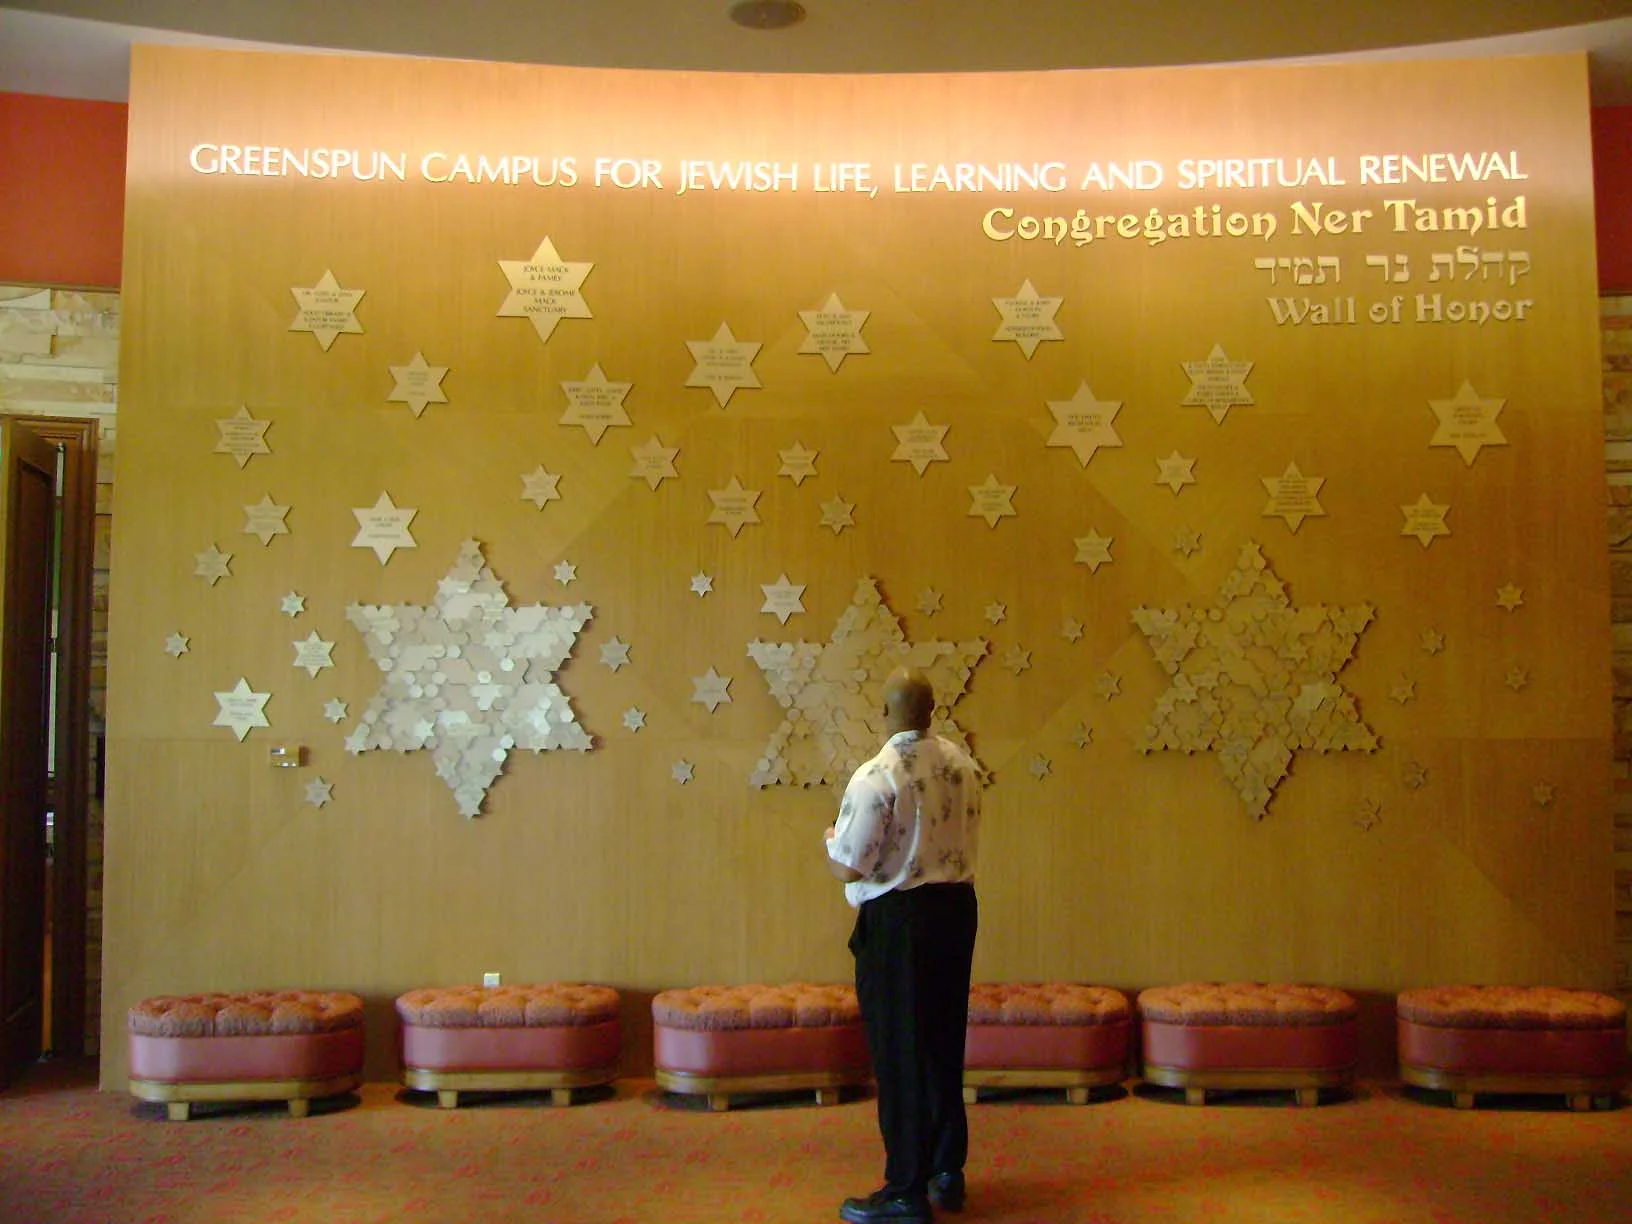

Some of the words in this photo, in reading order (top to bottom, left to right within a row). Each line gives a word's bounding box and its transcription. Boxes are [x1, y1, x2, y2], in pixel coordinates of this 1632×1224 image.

[189, 144, 407, 181] GREENSPUN
[420, 151, 579, 188] CAMPUS
[594, 158, 663, 189] FOR
[677, 160, 799, 195] JEWISH
[813, 162, 879, 199] LIFE,
[894, 161, 1067, 193] LEARNING
[1080, 160, 1164, 190] AND
[1177, 156, 1345, 190] SPIRITUAL
[1359, 151, 1528, 184] RENEWAL
[982, 203, 1278, 247] Congregation
[1290, 200, 1373, 237] Ner
[1384, 196, 1528, 237] Tamid
[1255, 255, 1341, 285] תמיד
[1365, 254, 1411, 283] נר
[1428, 245, 1531, 287] קהלת
[1267, 296, 1357, 325] Wall
[1368, 295, 1404, 323] of
[1415, 293, 1534, 326] Honor
